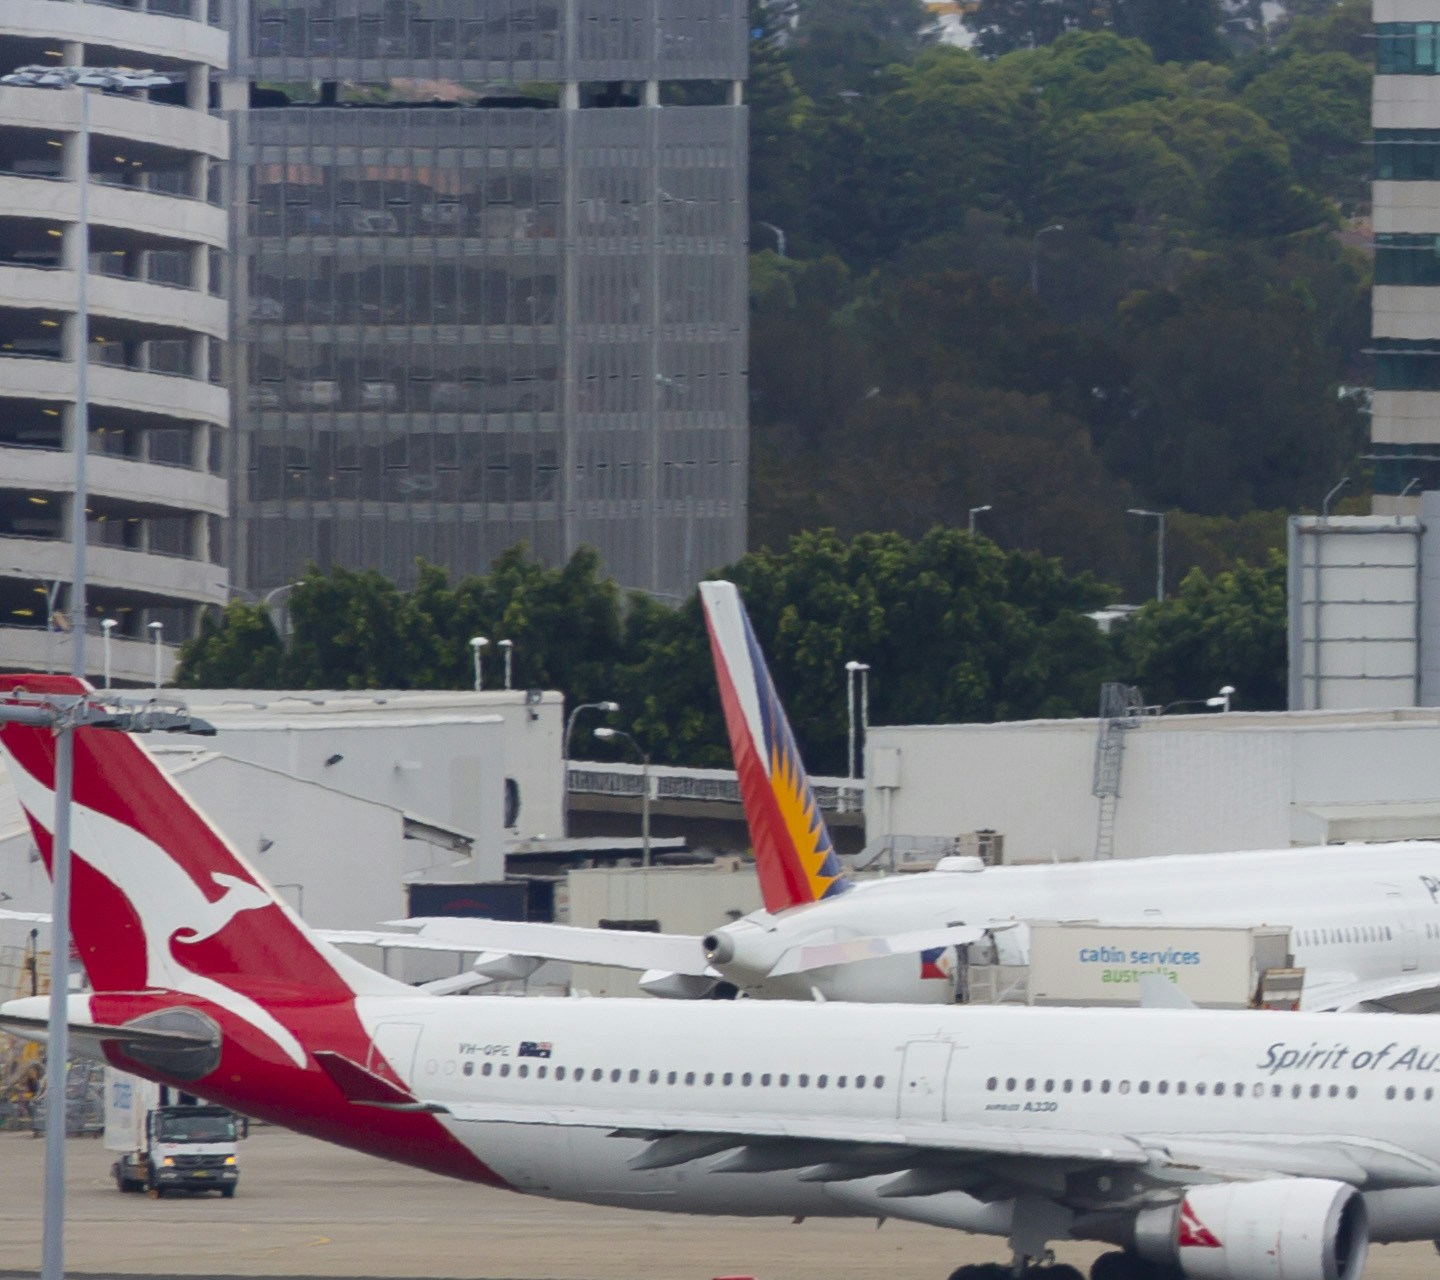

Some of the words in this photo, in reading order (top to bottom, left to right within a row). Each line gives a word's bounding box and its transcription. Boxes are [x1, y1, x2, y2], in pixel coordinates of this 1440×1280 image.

[1079, 945, 1126, 963] cabin
[1129, 946, 1200, 965] services
[1257, 1042, 1350, 1076] Spirit
[1350, 1041, 1398, 1071] of
